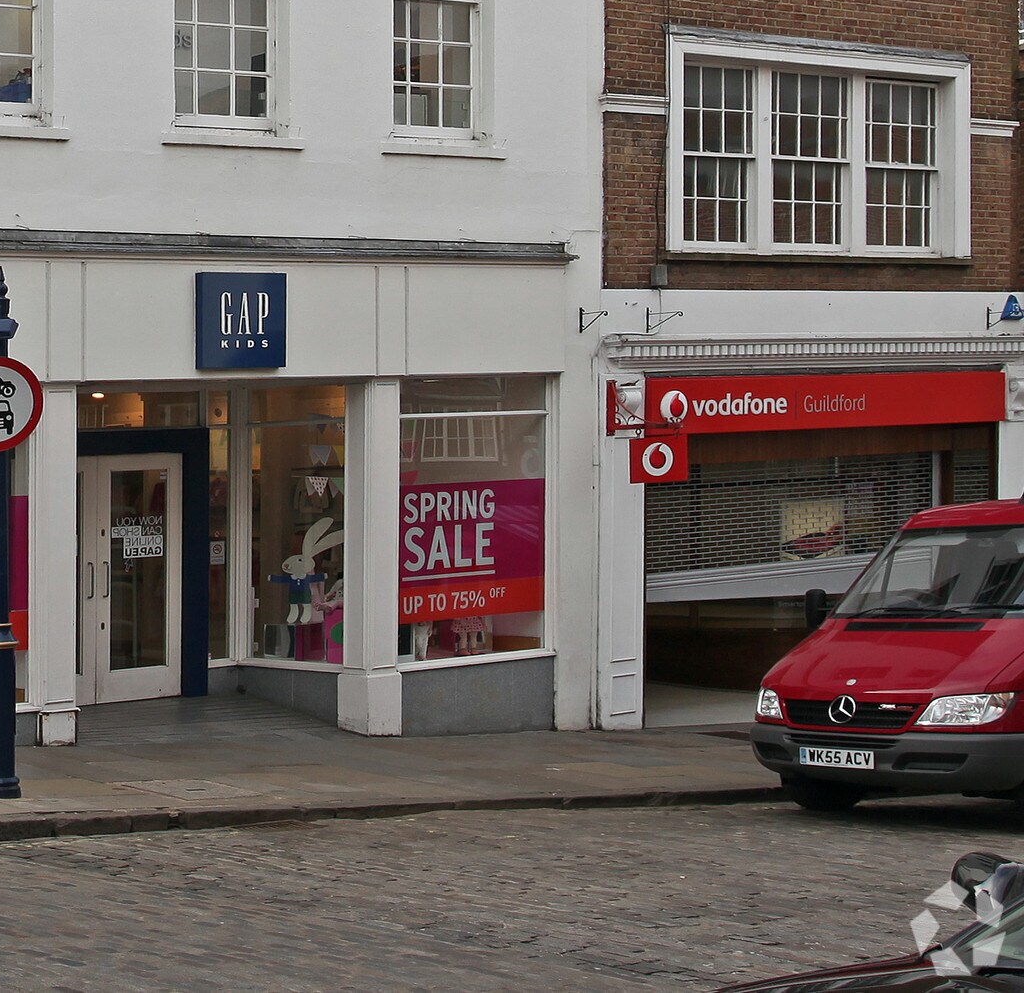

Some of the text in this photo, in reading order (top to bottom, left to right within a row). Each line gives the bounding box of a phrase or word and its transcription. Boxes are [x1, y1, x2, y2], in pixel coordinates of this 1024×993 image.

[221, 292, 269, 335] GAP
[221, 339, 269, 348] KIDS
[692, 392, 866, 416] vodafone Guildford
[404, 488, 496, 524] SPRING
[404, 522, 495, 572] SALE
[403, 587, 506, 615] UP TO 75% OFF
[808, 749, 871, 765] WK55 ACV
